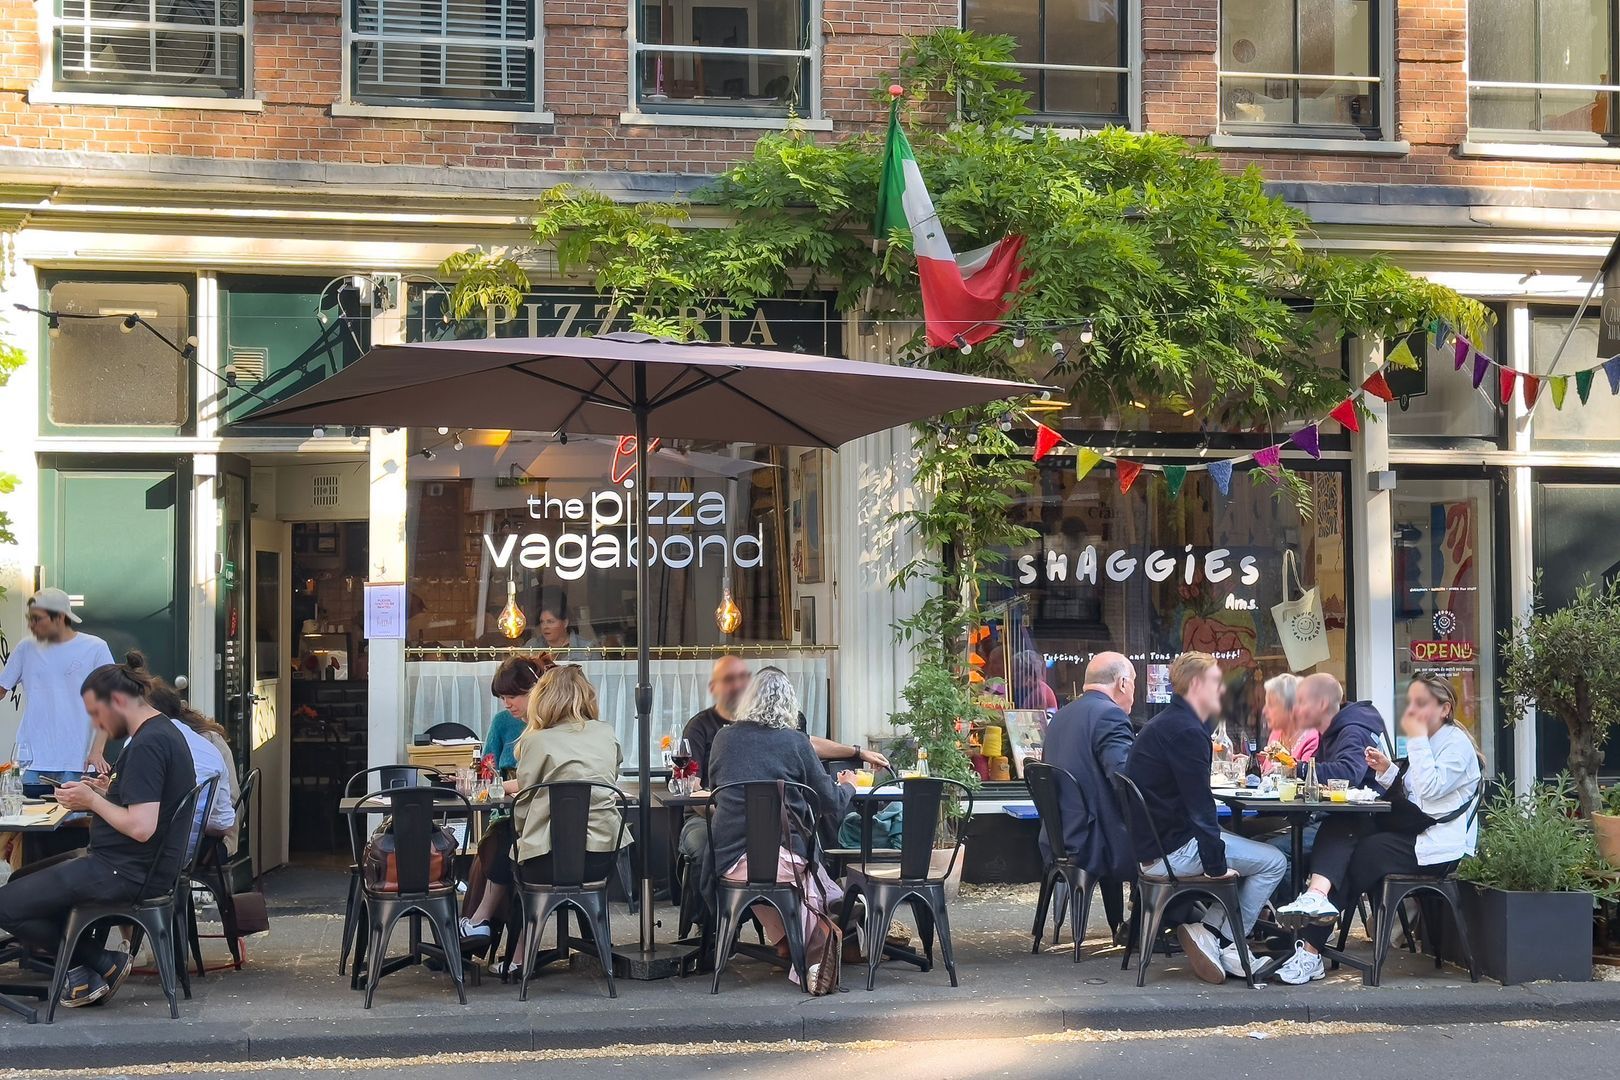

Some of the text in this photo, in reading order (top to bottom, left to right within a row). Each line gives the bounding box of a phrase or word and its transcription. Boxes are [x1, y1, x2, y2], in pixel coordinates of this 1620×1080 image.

[527, 479, 727, 537] the pizza
[483, 523, 764, 581] vagabond
[1129, 652, 1145, 660] and
[1415, 643, 1460, 659] OPEN
